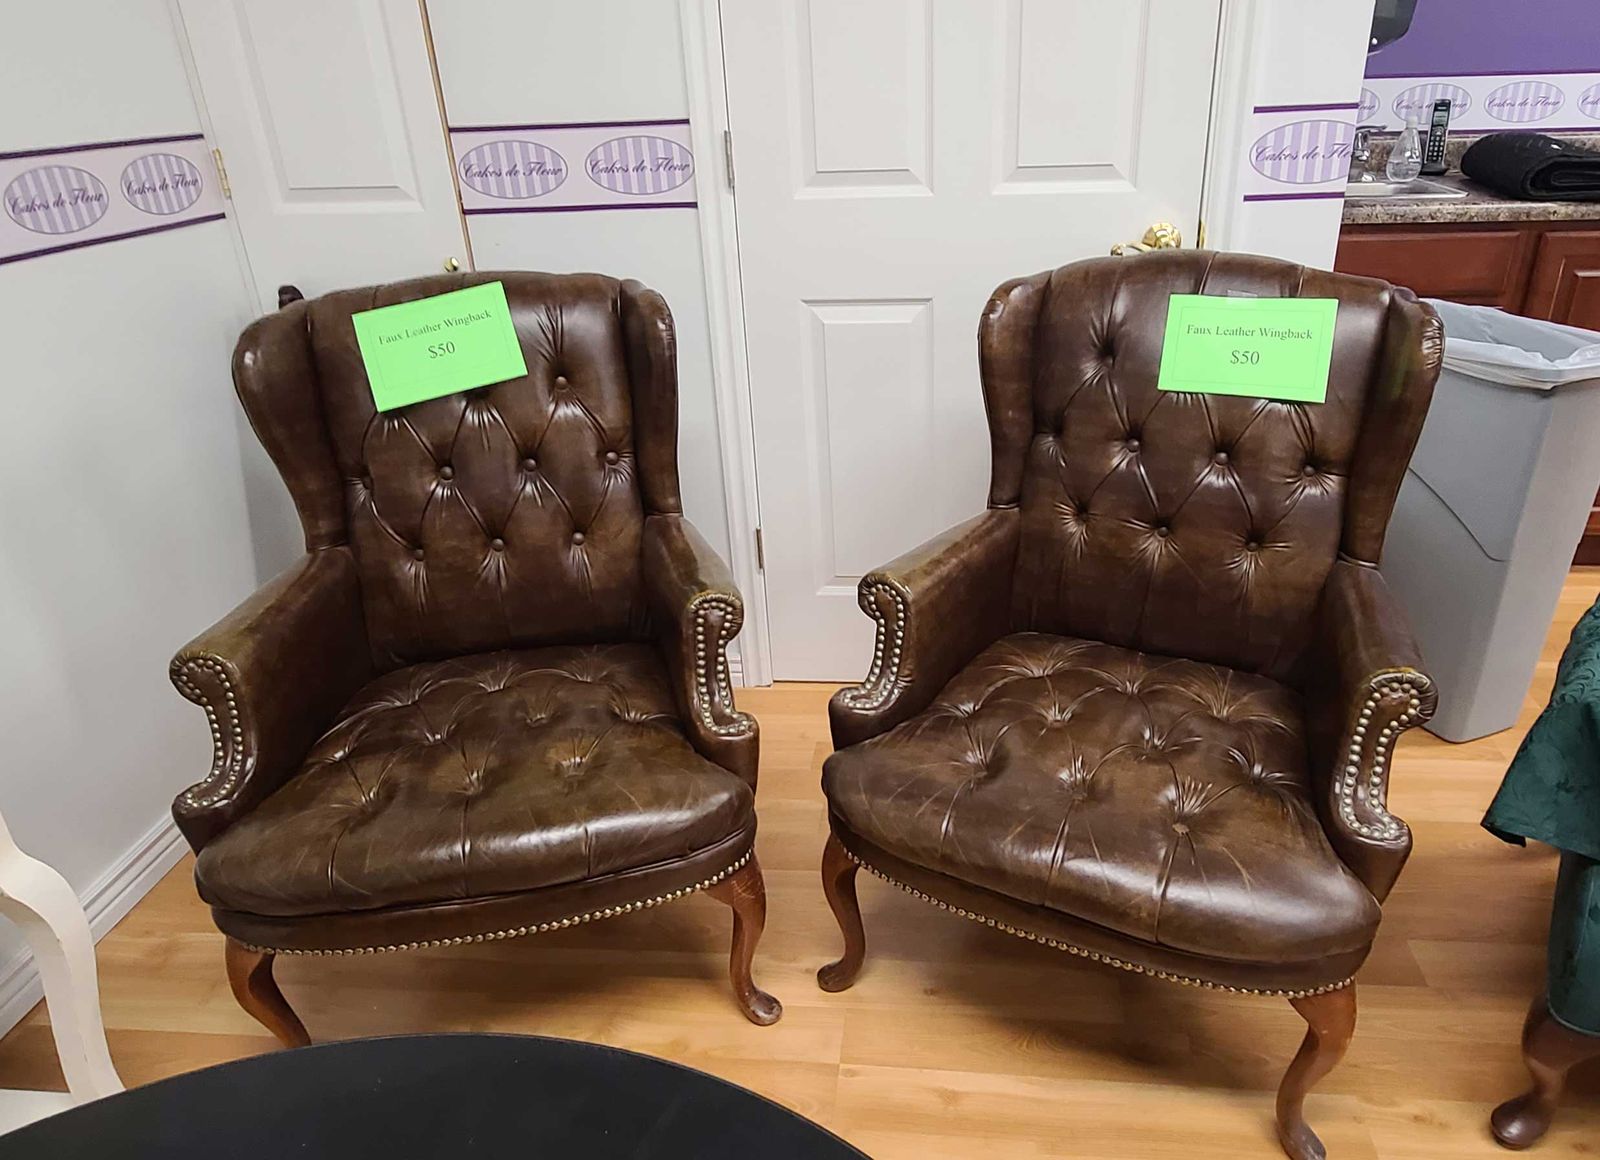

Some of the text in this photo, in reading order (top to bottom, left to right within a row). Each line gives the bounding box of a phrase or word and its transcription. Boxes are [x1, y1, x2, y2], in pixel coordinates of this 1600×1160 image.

[1488, 95, 1561, 108] Cakes de Fleur
[1255, 145, 1299, 161] Cakes
[1302, 145, 1320, 160] de
[463, 161, 563, 178] Cakes de Fleur
[589, 157, 690, 176] Cakes de Fleur
[124, 173, 200, 197] Cakes de Fleur
[8, 188, 104, 215] Cakes de Fleur
[378, 310, 493, 345] Faux Leather Wingback
[1186, 324, 1313, 341] Faux Leather Wingback
[427, 341, 456, 359] $50
[1230, 349, 1260, 365] $50
